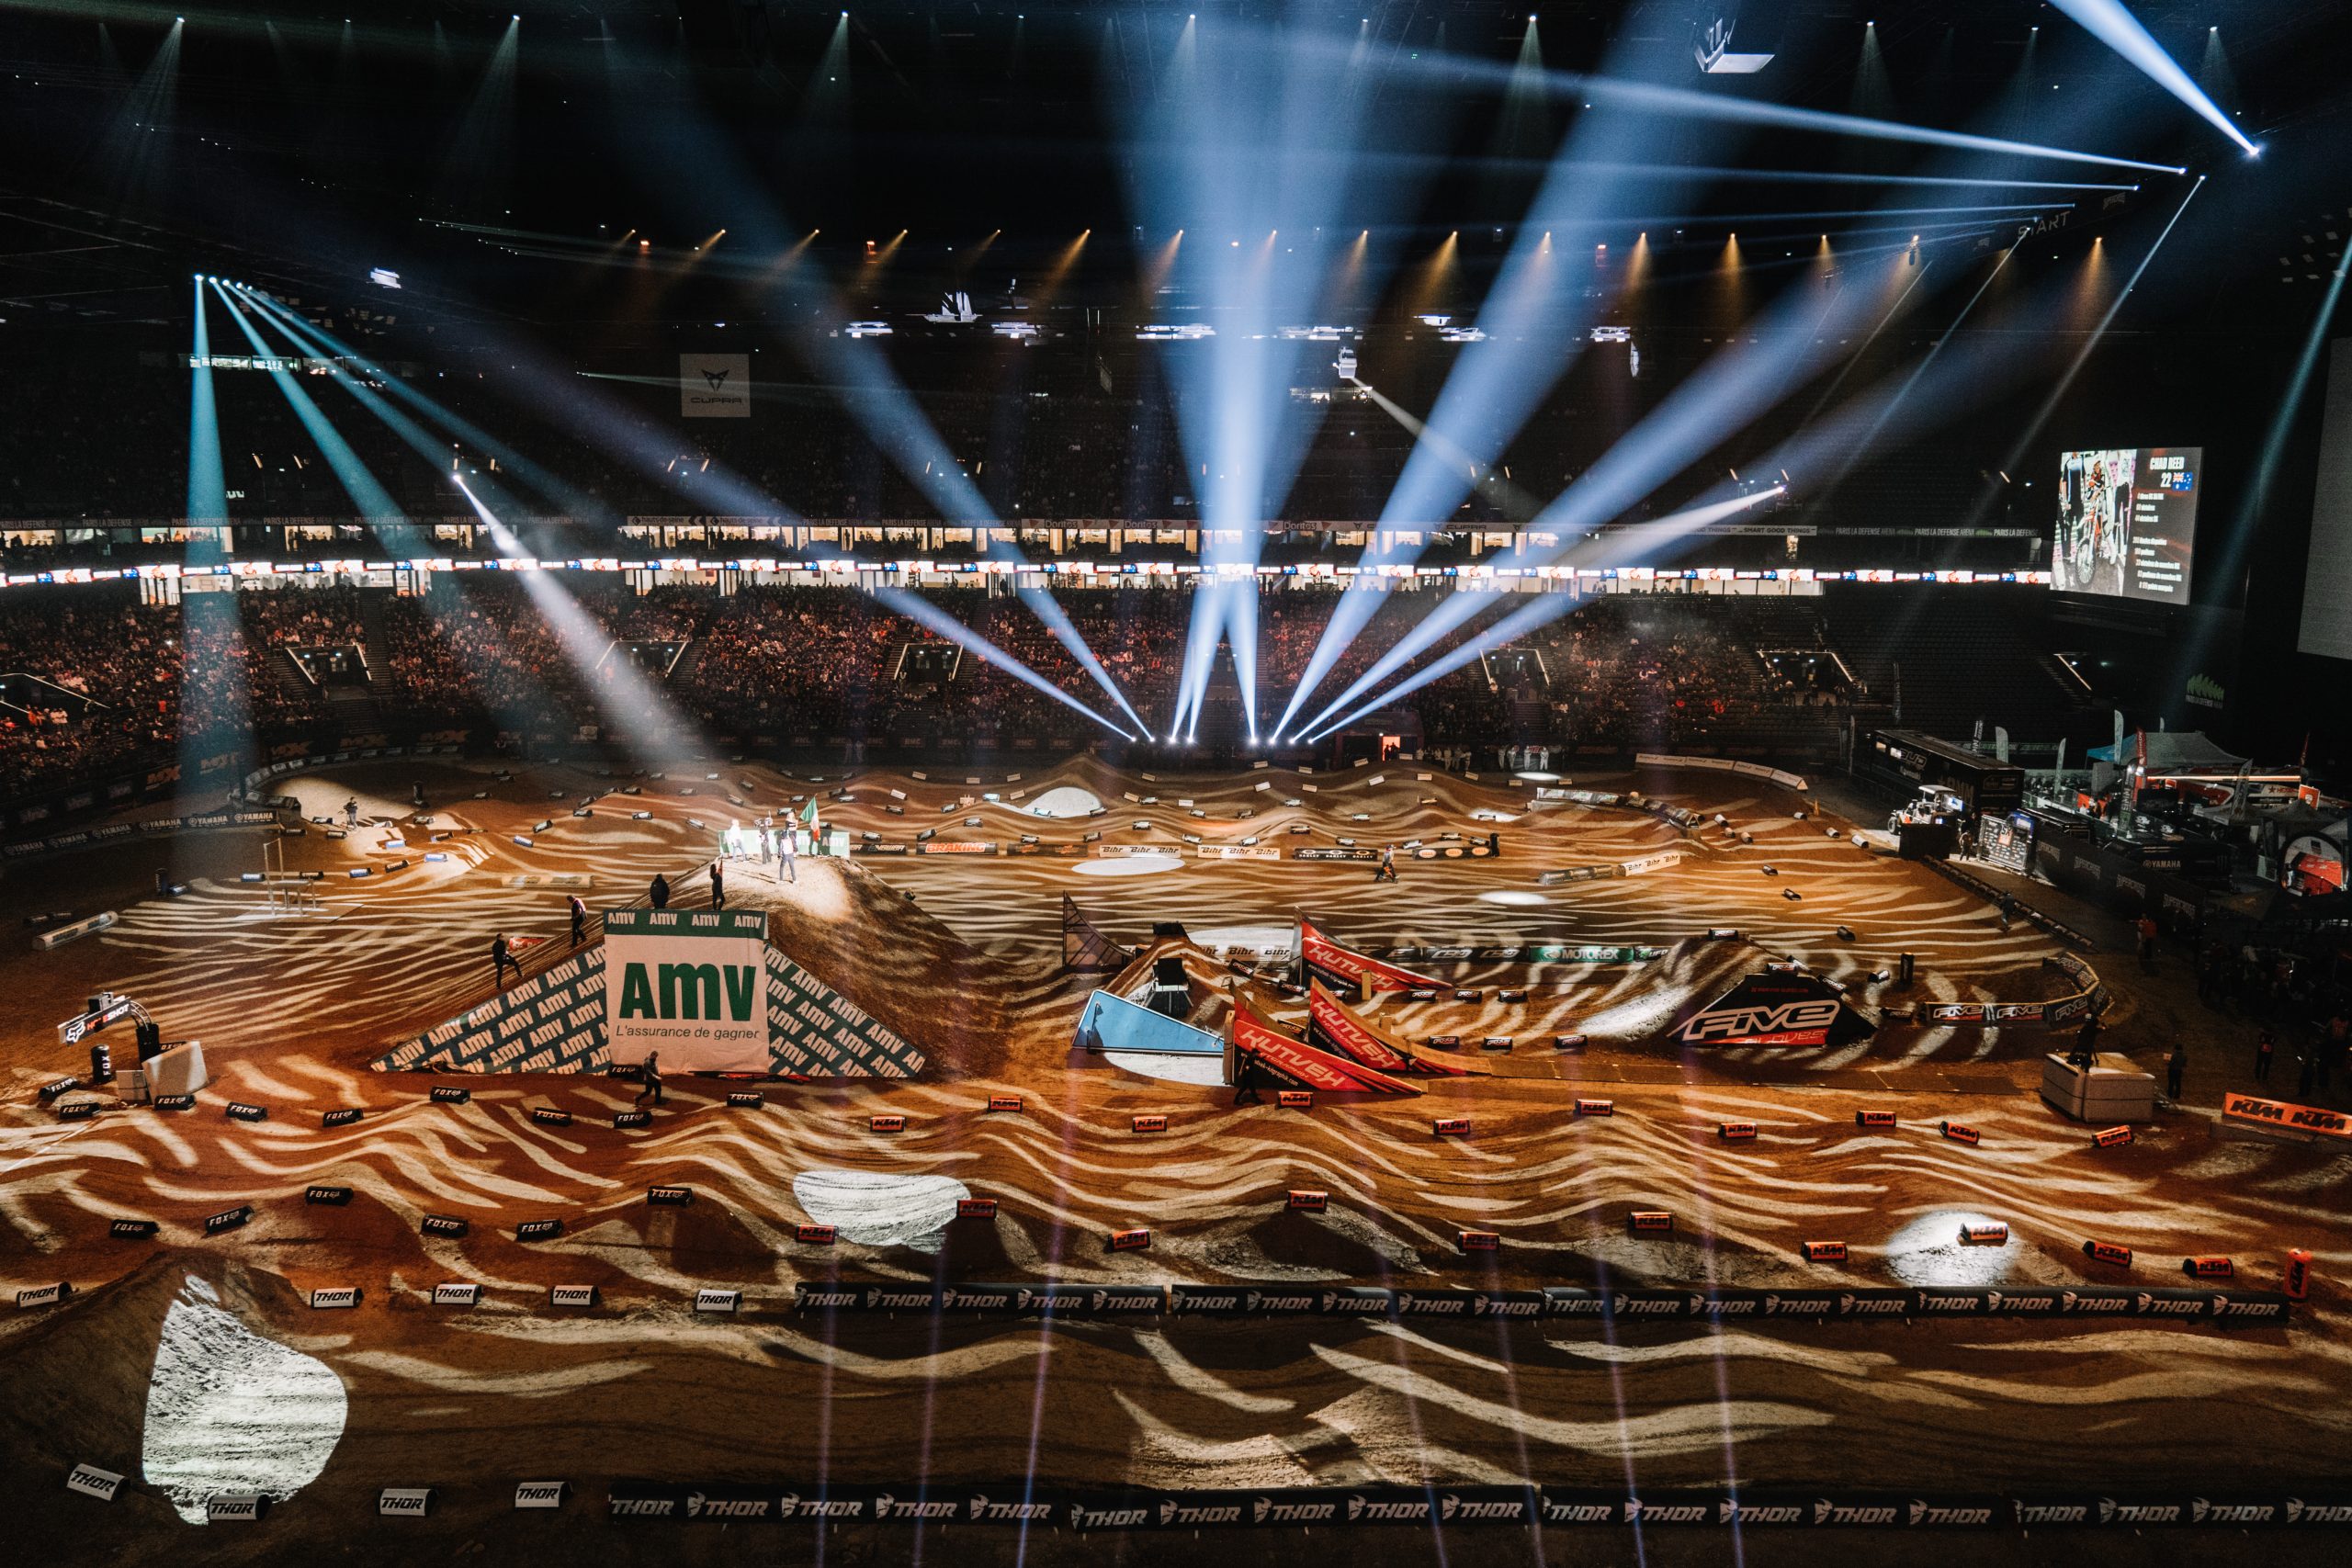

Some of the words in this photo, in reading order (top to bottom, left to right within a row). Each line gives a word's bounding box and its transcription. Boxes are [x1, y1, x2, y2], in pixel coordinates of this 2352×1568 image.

[2161, 472, 2172, 488] 22
[1045, 520, 1078, 529] Doritos
[1125, 520, 1157, 529] Doritos
[1283, 521, 1317, 531] Doritos
[1994, 528, 2009, 536] PARIS
[2008, 528, 2016, 536] LA
[198, 815, 229, 825] YAMAHA
[243, 812, 274, 821] YAMAHA
[926, 843, 987, 853] BRAKING
[1228, 847, 1250, 855] Bihr
[1645, 858, 1661, 867] Bihr
[1664, 853, 1679, 863] Bihr
[2152, 860, 2182, 869] YAMAHA
[1227, 947, 1255, 955] Bihr
[1562, 949, 1619, 960] MOTOREX
[87, 1003, 130, 1031] HESHOT
[616, 1025, 690, 1038] L'assurance
[694, 1026, 710, 1038] de
[714, 1029, 760, 1041] gagner
[103, 1055, 111, 1076] FOX
[612, 1066, 628, 1076] FOX
[51, 1080, 66, 1093] FOX
[435, 1088, 452, 1097] FOX
[158, 1096, 176, 1106] FOX
[62, 1105, 80, 1114] FOX
[230, 1104, 249, 1114] FOX
[2231, 1099, 2285, 1121] KTM
[326, 1110, 345, 1121] FOX
[617, 1113, 636, 1123] FOX
[2291, 1110, 2346, 1130] KTM
[310, 1190, 330, 1199] FOX
[209, 1213, 230, 1227] FOX
[426, 1218, 448, 1229] FOX
[114, 1223, 134, 1232] FOX
[522, 1224, 542, 1234] FOX
[1973, 1225, 2005, 1235] KTM
[1813, 1245, 1845, 1256] KTM
[21, 1286, 57, 1302] THOR
[316, 1291, 352, 1303] THOR
[436, 1288, 473, 1298] THOR
[554, 1289, 589, 1300] THOR
[699, 1293, 732, 1304] THOR
[805, 1293, 857, 1306] THOR
[957, 1294, 1008, 1308] THOR
[1185, 1296, 1238, 1309] THOR
[1337, 1298, 1389, 1311] THOR
[2003, 1297, 2053, 1311] THOR
[1781, 1299, 1831, 1313] THOR
[2229, 1303, 2279, 1316] THOR
[72, 1470, 116, 1494] THOR
[517, 1486, 559, 1501] THOR
[210, 1501, 254, 1516] THOR
[381, 1497, 424, 1510] THOR
[611, 1500, 674, 1516] THOR
[706, 1501, 769, 1517] THOR
[893, 1502, 958, 1517] THOR
[1366, 1503, 1430, 1518] THOR
[1643, 1506, 1708, 1521] THOR
[2117, 1506, 2181, 1523] THOR
[1084, 1509, 1148, 1526] THOR
